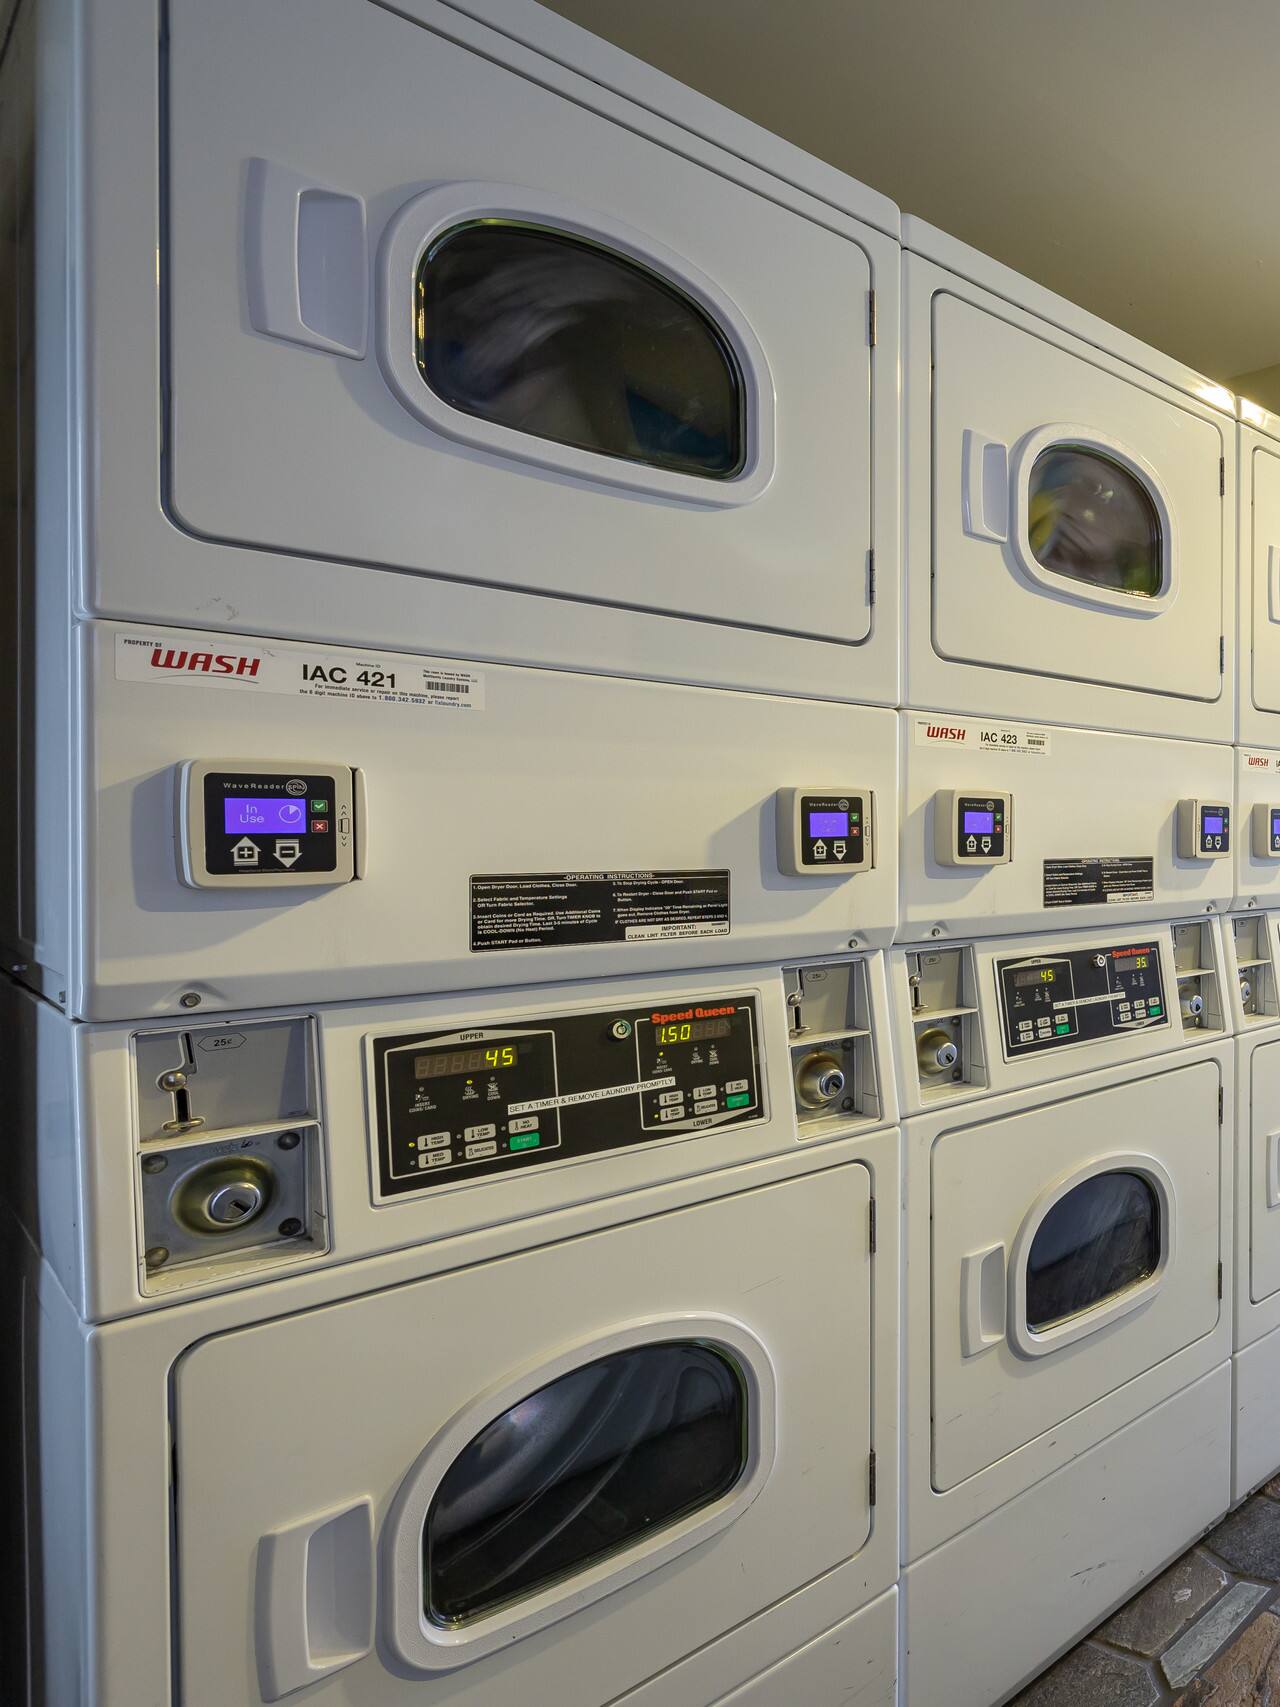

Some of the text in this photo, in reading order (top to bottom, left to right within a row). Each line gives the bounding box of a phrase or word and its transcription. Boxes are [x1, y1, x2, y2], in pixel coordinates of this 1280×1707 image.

[123, 639, 153, 647] PROPERTY
[150, 648, 261, 676] WASH
[303, 664, 395, 688] IAC 421
[927, 726, 966, 740] WASH
[980, 731, 998, 743] IAC
[1000, 733, 1018, 745] 423
[1248, 757, 1269, 767] WASH
[223, 782, 284, 790] WaveReader
[245, 803, 258, 814] In
[240, 814, 265, 824] Use
[1112, 949, 1131, 958] Speed
[1040, 969, 1054, 981] 45
[651, 1006, 736, 1024] Speed Queen
[460, 1032, 484, 1041] UPPER
[485, 1047, 513, 1067] 45
[509, 1104, 525, 1113] SET
[535, 1098, 559, 1109] TIMER
[568, 1091, 600, 1103] REMOVE
[601, 1085, 635, 1098] LAUNDRY
[636, 1078, 674, 1091] PROMPTLY
[693, 1118, 713, 1127] LOWER
